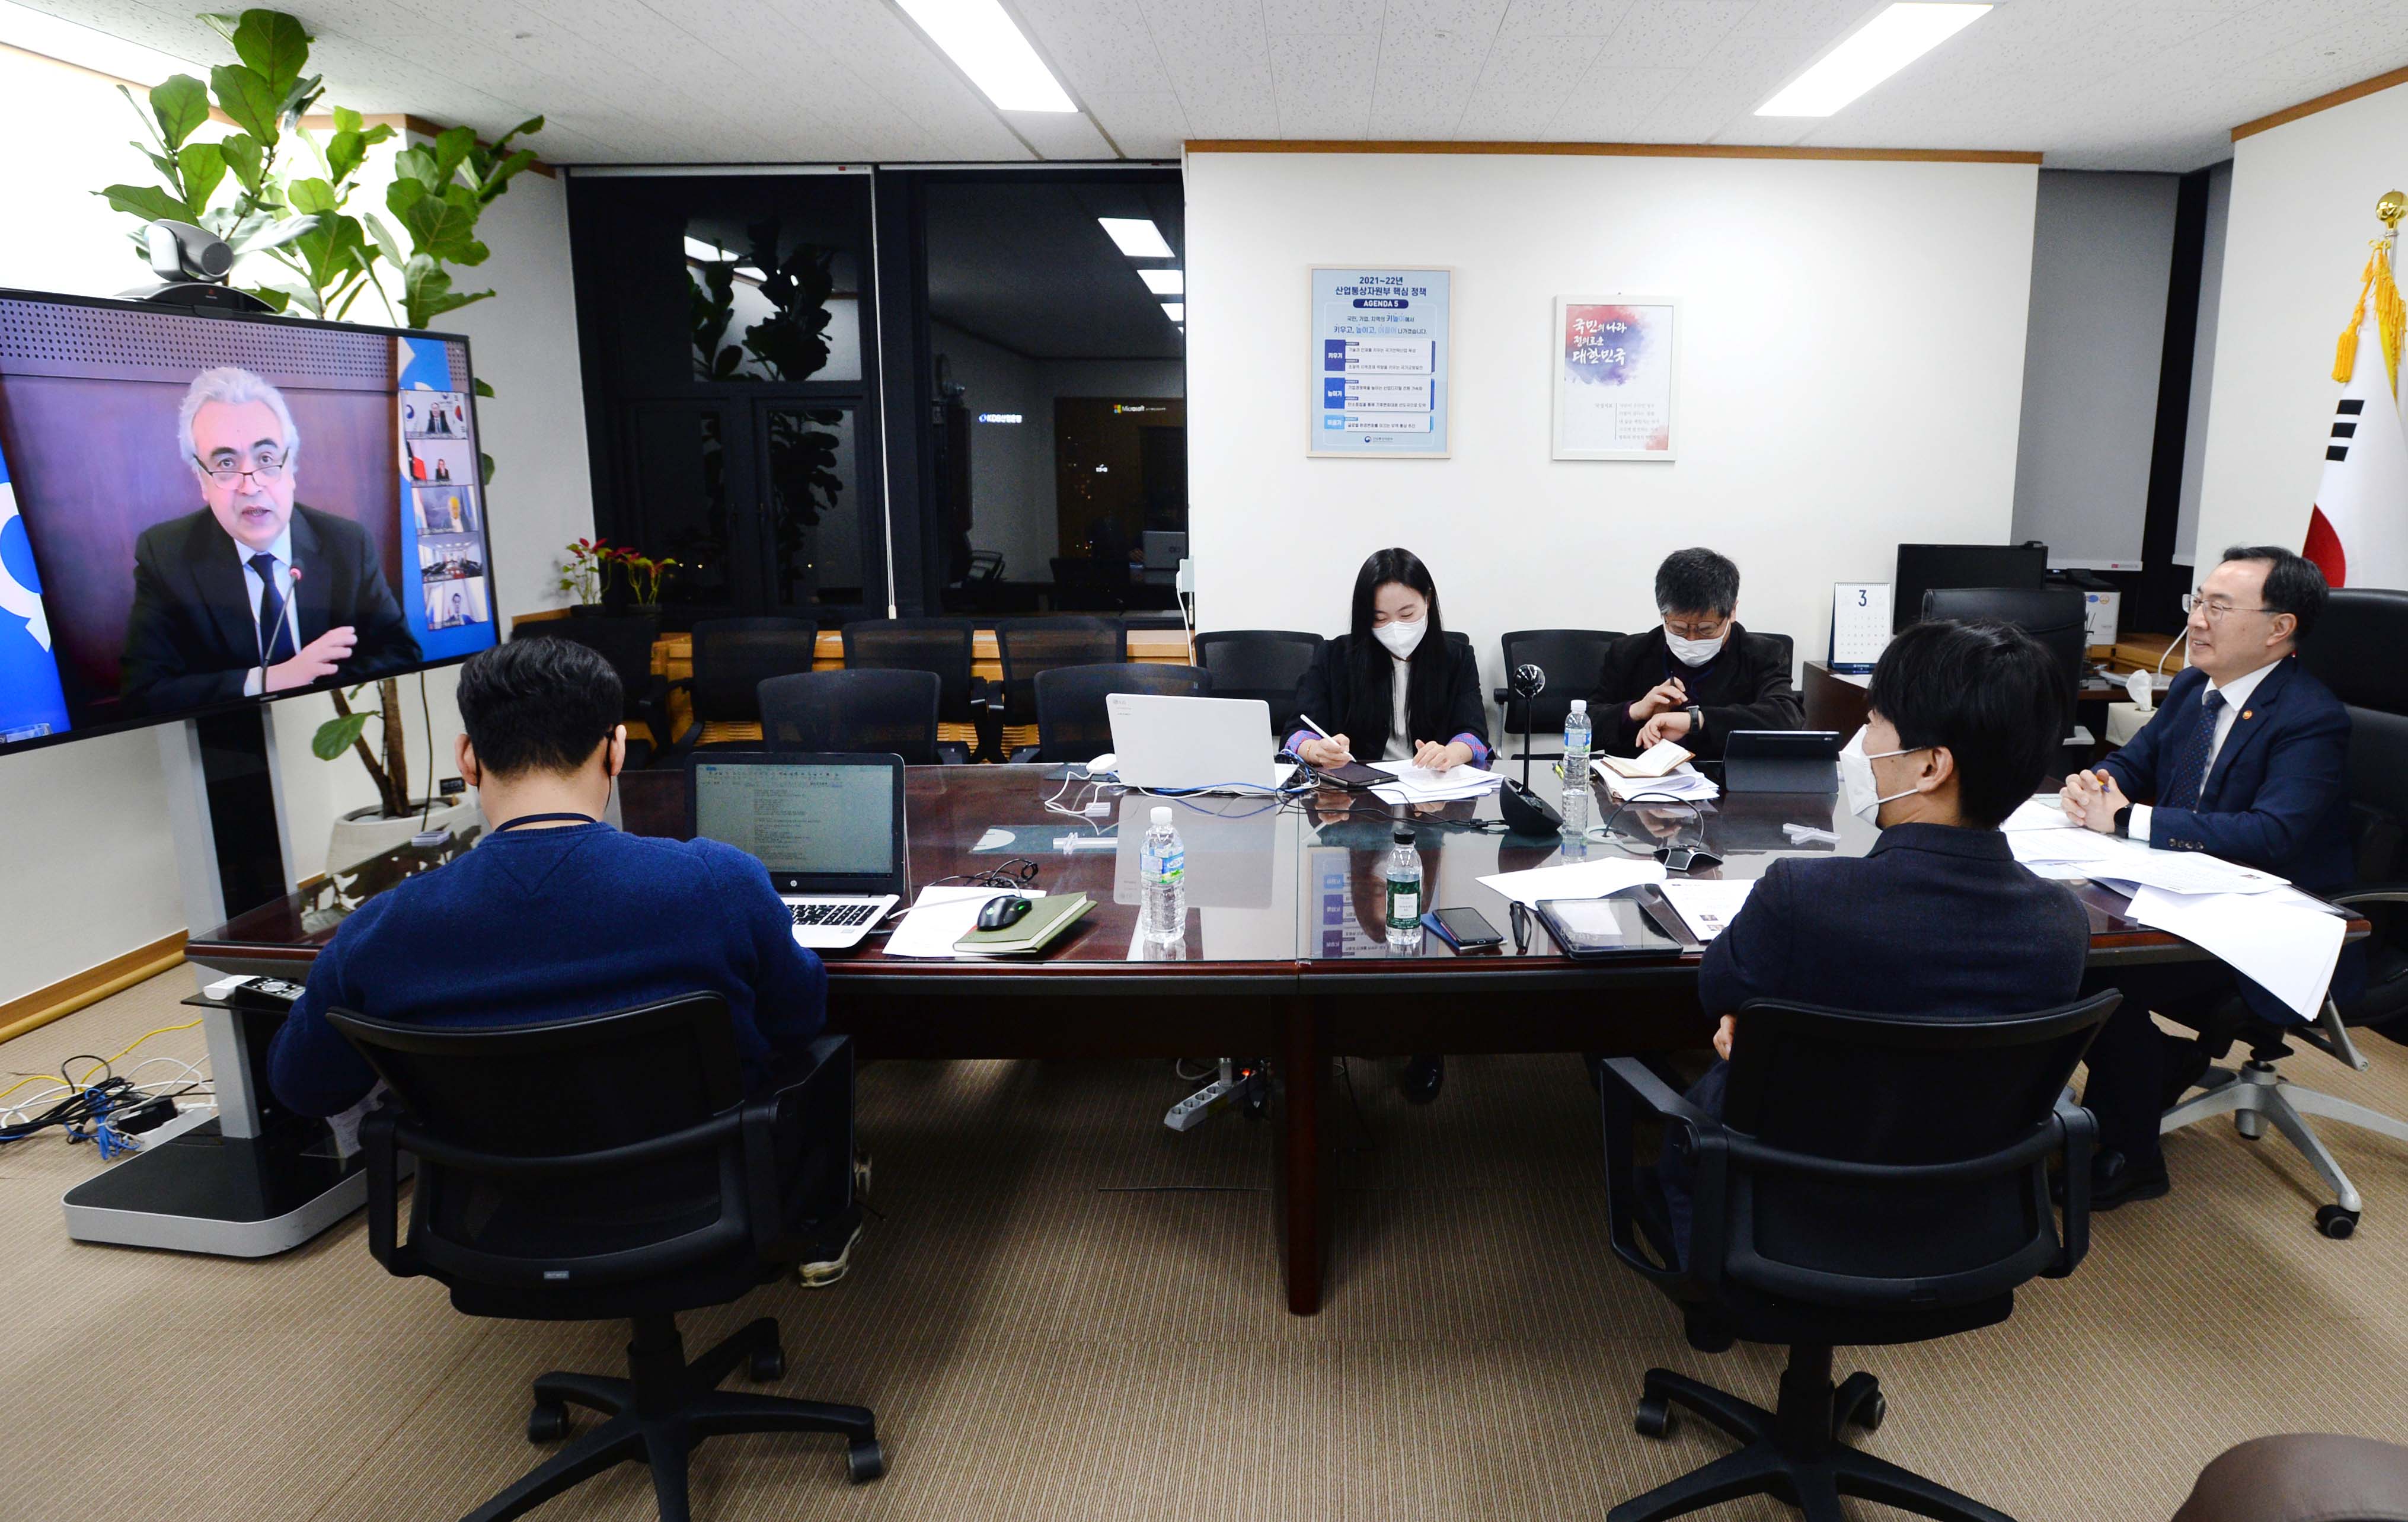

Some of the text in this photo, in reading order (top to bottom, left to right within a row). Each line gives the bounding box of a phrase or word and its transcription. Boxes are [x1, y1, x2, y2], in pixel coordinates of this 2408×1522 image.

[1359, 276, 1403, 286] 2021~22년
[1336, 286, 1427, 296] 산업통상자원부 핵심 정책
[1573, 318, 1627, 334] 국민의 나라
[1573, 335, 1604, 347] 정의로운
[1572, 347, 1626, 365] 대한민국
[1858, 589, 1867, 607] 3
